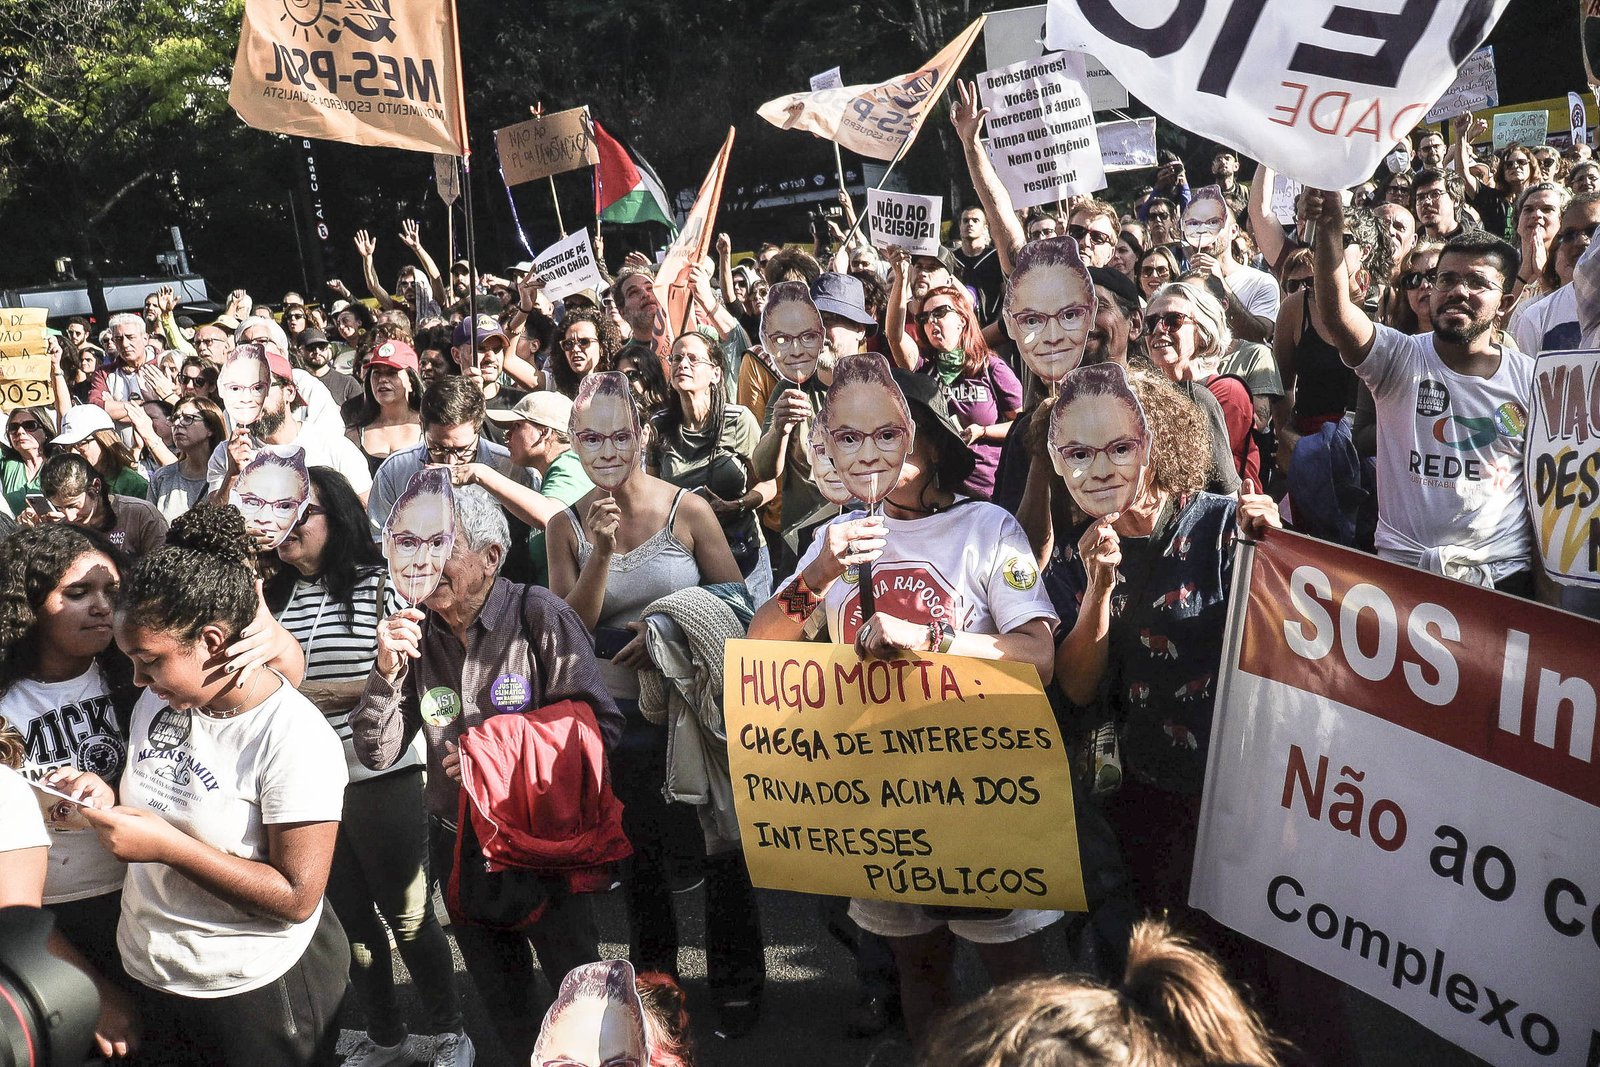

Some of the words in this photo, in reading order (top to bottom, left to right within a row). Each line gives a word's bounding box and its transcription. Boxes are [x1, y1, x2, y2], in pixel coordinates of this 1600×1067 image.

[986, 58, 1067, 90] Devastadores!
[1004, 90, 1039, 108] Vocês
[1041, 82, 1062, 99] não
[990, 108, 1043, 129] merecem
[1045, 103, 1053, 115] a
[1054, 96, 1081, 114] água
[993, 131, 1026, 150] limpa
[1027, 126, 1048, 143] que
[1050, 115, 1092, 136] tomam!
[1007, 150, 1032, 167] Nem
[1034, 150, 1041, 160] o
[1043, 136, 1090, 157] oxigênio
[1036, 160, 1057, 176] que
[1023, 170, 1077, 193] respiram!
[877, 197, 903, 219] NÃO
[905, 204, 927, 221] AO
[871, 215, 883, 232] PL
[884, 219, 935, 240] 2159/21
[555, 265, 567, 278] NO
[567, 255, 590, 273] CHÃO
[564, 247, 576, 261] DE
[576, 240, 587, 255] PÉ
[1408, 449, 1481, 482] REDE
[1409, 474, 1480, 493] SUSTENTABIL
[1283, 564, 1462, 706] SOS
[1498, 628, 1598, 764] In
[740, 656, 826, 713] HUGO
[739, 723, 831, 762] CHEGA
[835, 731, 873, 756] DE
[880, 726, 1052, 754] INTERESSES
[137, 748, 186, 763] MEANS
[184, 754, 220, 792] AMILY
[148, 798, 168, 812] 2002
[743, 773, 871, 806] PRIVADOS
[881, 777, 965, 808] ACIMA
[972, 775, 1041, 805] DOS
[753, 822, 933, 857] INTERESSES
[1280, 743, 1408, 853] Não
[1429, 824, 1517, 902] ao
[1543, 876, 1600, 960] c
[863, 859, 1048, 896] PÚBLICOS
[1266, 874, 1560, 1057] Complexo
